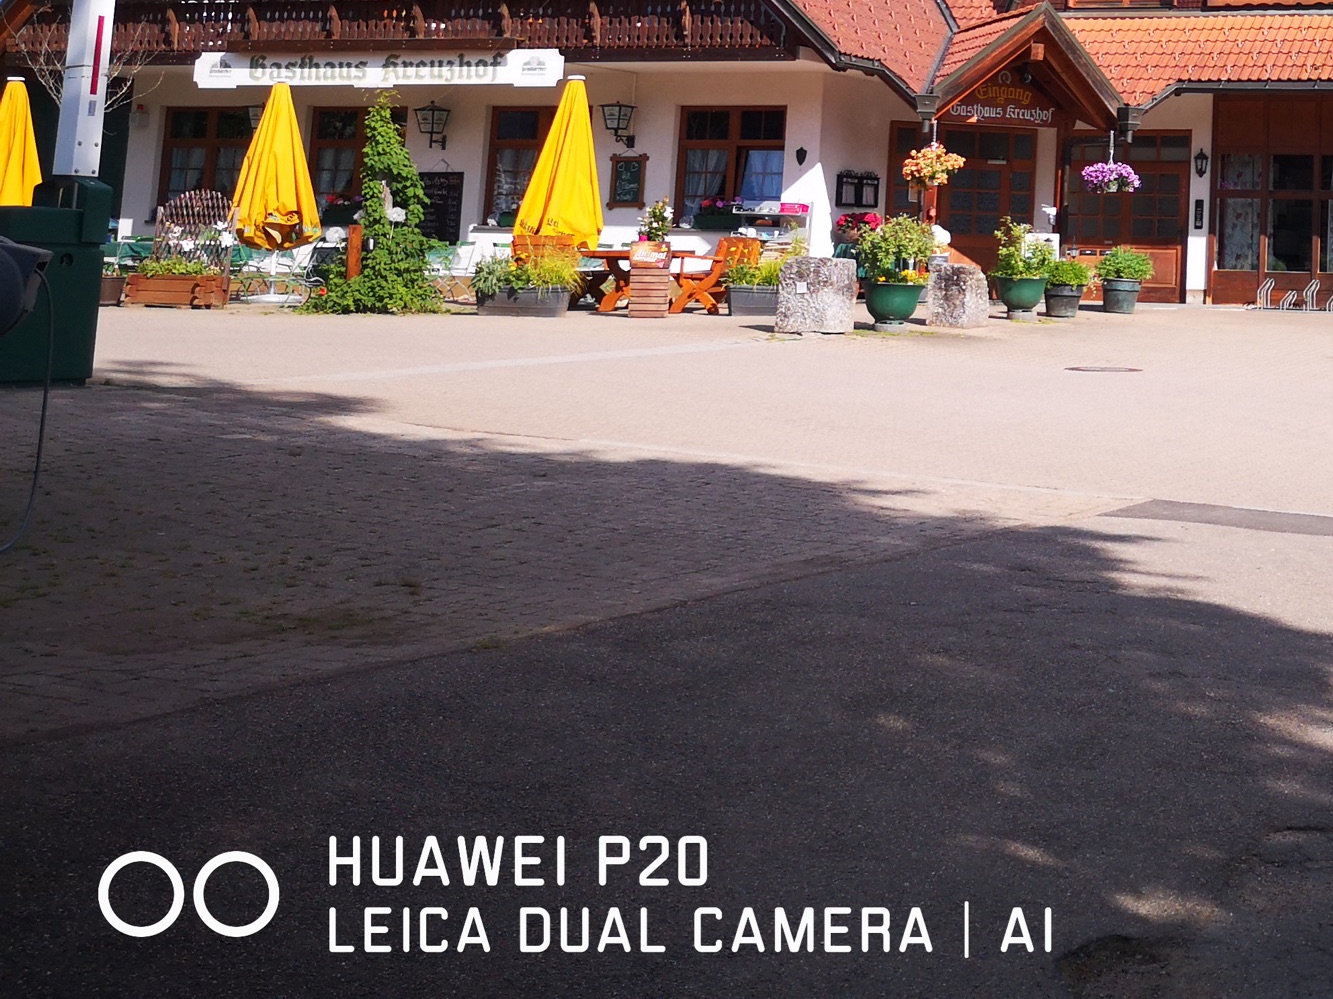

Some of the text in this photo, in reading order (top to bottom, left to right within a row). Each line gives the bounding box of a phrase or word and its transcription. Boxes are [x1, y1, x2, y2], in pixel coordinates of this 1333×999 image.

[249, 52, 504, 84] Gasthaus Kreuzhof
[976, 83, 1032, 104] Eingang
[949, 102, 1055, 124] Gasthaus Kreuzhof
